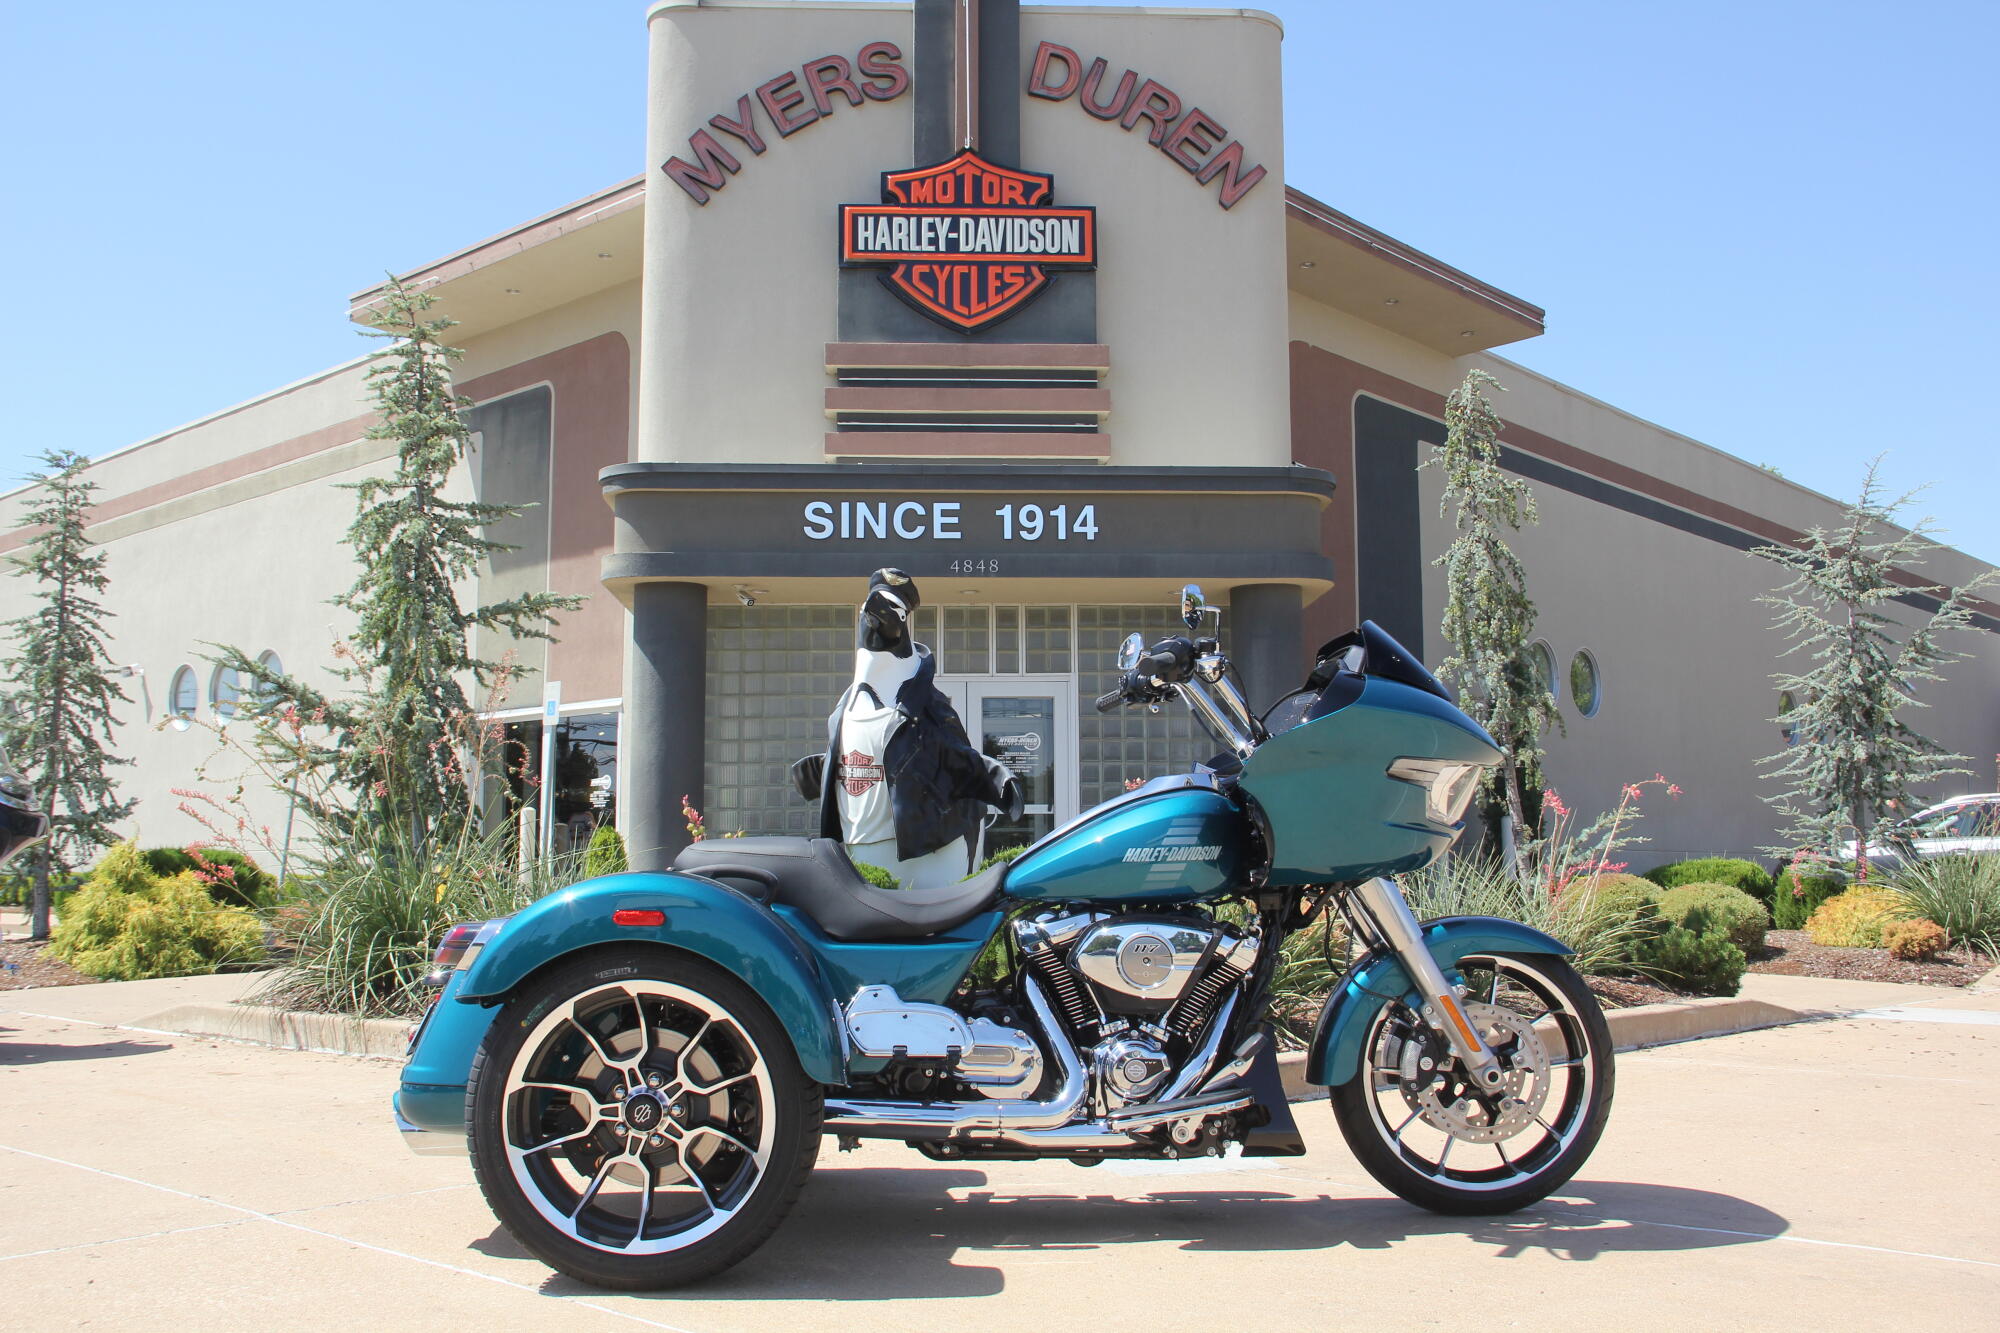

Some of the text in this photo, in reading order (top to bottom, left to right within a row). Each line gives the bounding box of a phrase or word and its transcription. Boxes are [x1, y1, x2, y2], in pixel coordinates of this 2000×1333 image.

[661, 41, 1268, 211] MYERS DUREN
[910, 162, 1028, 205] MOTOR
[857, 215, 1080, 254] HARLEY-DAVIDSON
[912, 264, 1025, 316] CYCLES
[803, 501, 1099, 541] SINCE 1914
[950, 559, 999, 573] 4848
[1122, 846, 1222, 862] HARLEY-DAVIDSON
[1133, 943, 1160, 953] 117
